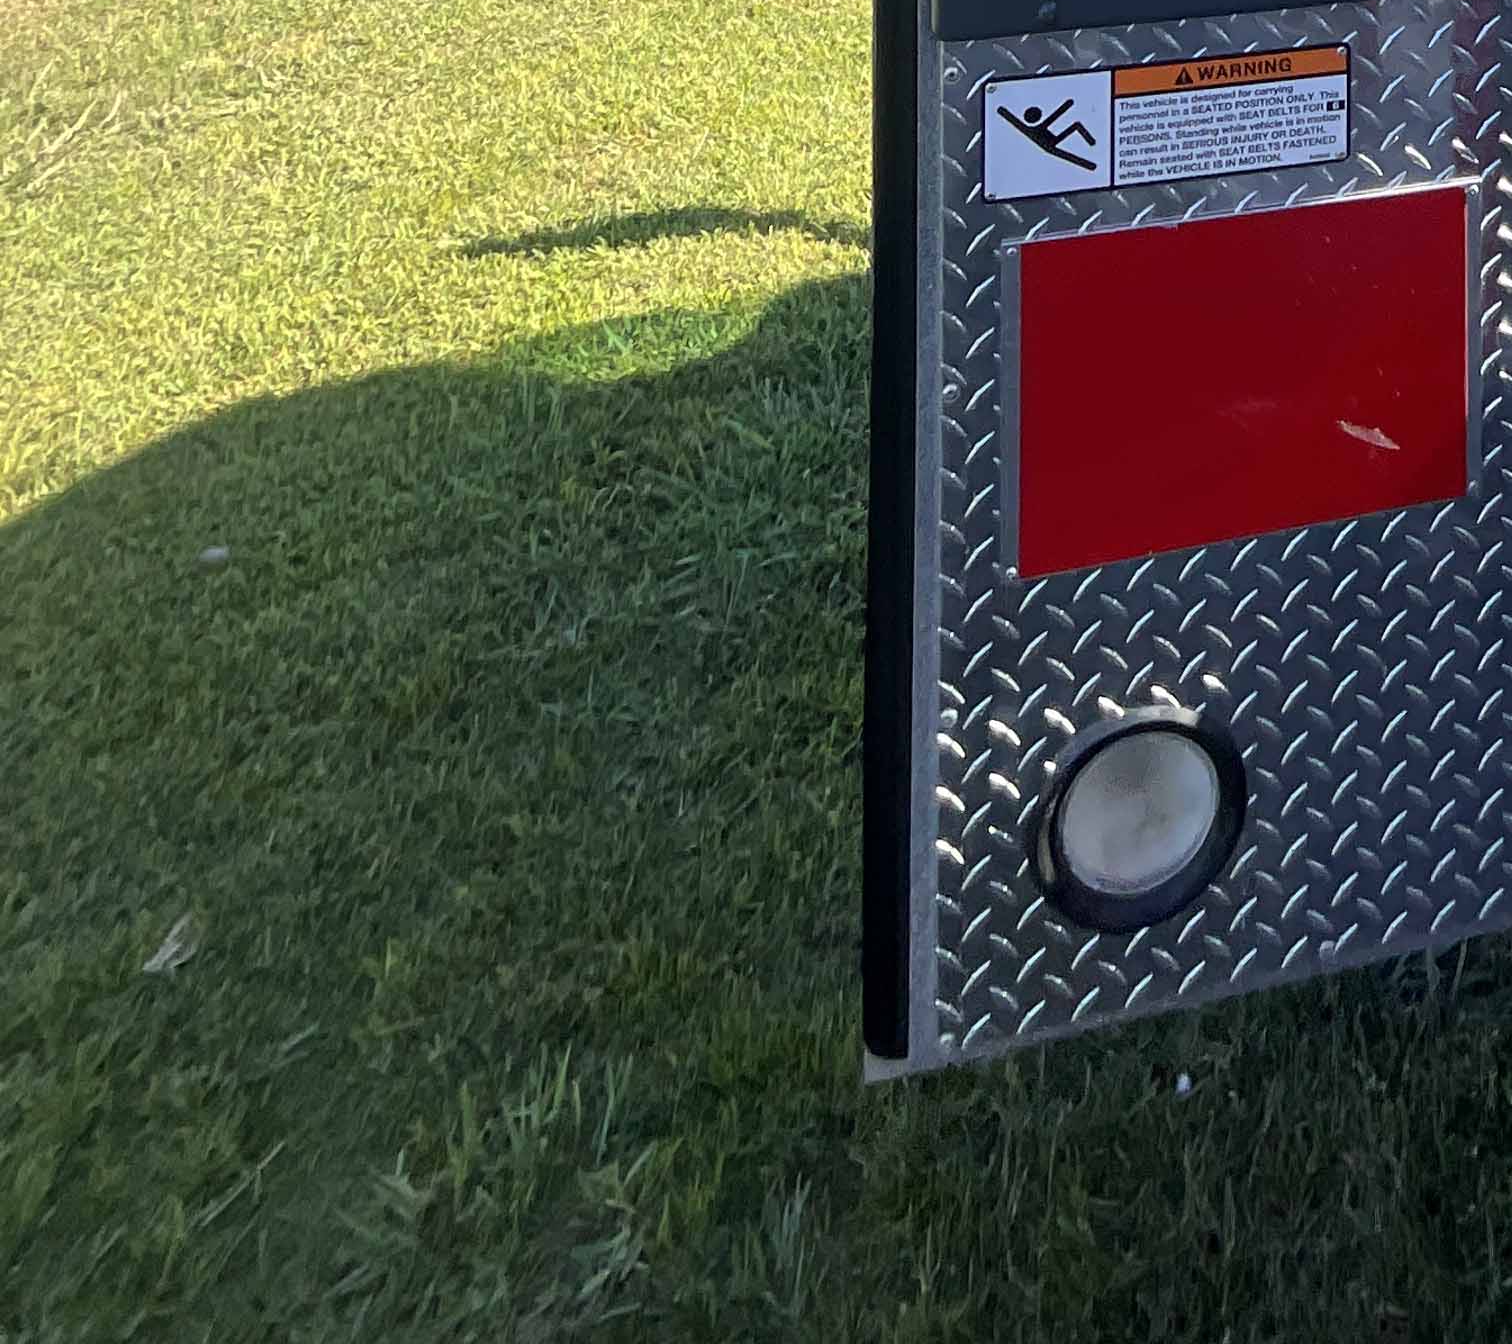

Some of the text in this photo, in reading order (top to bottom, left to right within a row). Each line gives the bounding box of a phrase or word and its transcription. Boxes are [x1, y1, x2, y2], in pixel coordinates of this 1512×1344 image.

[1197, 58, 1291, 80] WARNING
[1120, 102, 1140, 110] This
[1143, 98, 1178, 108] vehicle
[1191, 90, 1236, 103] designed
[1238, 89, 1251, 97] for
[1255, 86, 1293, 97] carrying
[1171, 108, 1180, 116] in
[1191, 103, 1232, 114] SEATED
[1235, 97, 1283, 109] POSITION
[1321, 91, 1339, 99] This
[1119, 123, 1154, 133] vehicle
[1167, 116, 1214, 129] equipped
[1216, 113, 1236, 122] with
[1239, 110, 1264, 120] SEAT
[1268, 106, 1300, 116] BELTS
[1303, 104, 1323, 112] FOR
[1222, 124, 1247, 133] while
[1250, 120, 1283, 130] vehicle
[1307, 113, 1340, 123] motion
[1119, 149, 1137, 157] can
[1140, 145, 1168, 155] result
[1182, 137, 1228, 149] SERIOUS
[1231, 133, 1267, 143] INJURY
[1272, 131, 1286, 139] OR
[1119, 135, 1336, 168] Remain seated with SEAT BELTS FASTENED
[1119, 169, 1145, 179] while
[1166, 161, 1211, 174] VEHICLE
[1225, 158, 1235, 167] IN
